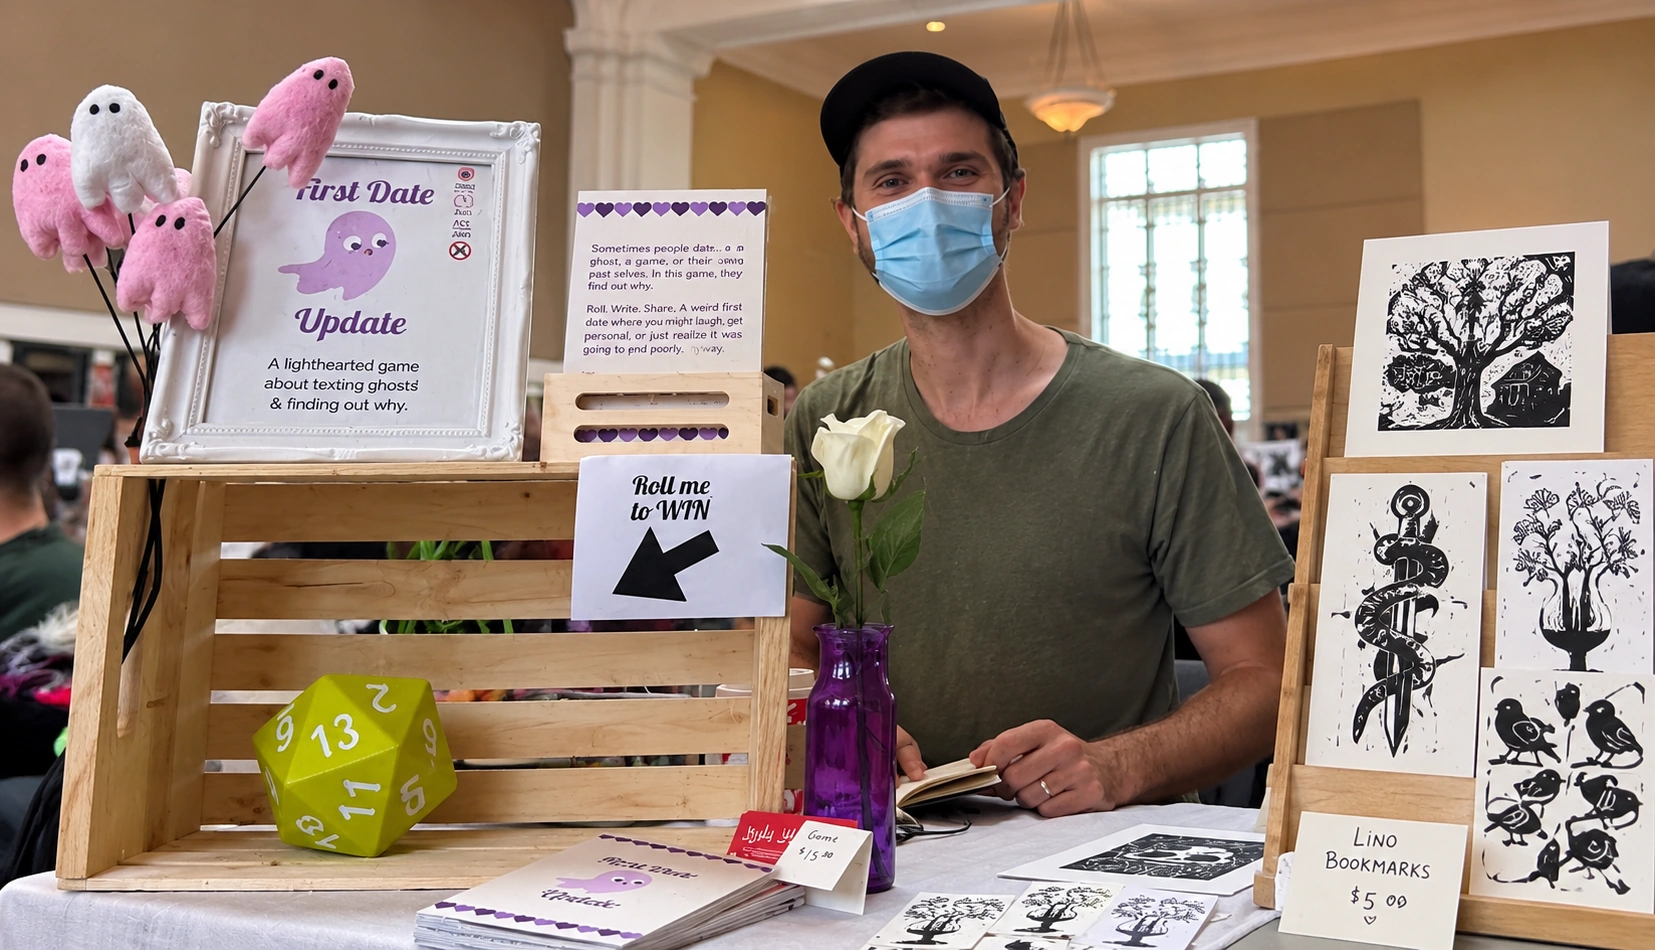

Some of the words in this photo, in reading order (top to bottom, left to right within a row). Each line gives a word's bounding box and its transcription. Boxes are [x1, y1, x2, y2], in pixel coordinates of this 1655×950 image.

[296, 177, 360, 202] First
[367, 180, 435, 205] Date
[591, 244, 650, 253] Sometimes
[654, 244, 689, 254] people
[590, 257, 622, 267] ghost,
[625, 258, 632, 266] a
[635, 258, 669, 267] game,
[672, 258, 684, 266] or
[688, 256, 713, 265] their
[589, 270, 611, 280] past
[614, 269, 649, 279] selves.
[652, 270, 661, 278] In
[664, 269, 683, 278] this
[686, 270, 718, 280] game,
[720, 269, 743, 280] they
[588, 282, 608, 291] find
[611, 283, 627, 291] out
[630, 282, 654, 292] why.
[586, 304, 608, 314] Roll.
[611, 304, 641, 313] Write.
[644, 304, 676, 313] Share.
[679, 303, 687, 312] A
[690, 303, 719, 312] weird
[722, 302, 743, 312] first
[294, 308, 407, 341] Update
[585, 318, 609, 327] date
[611, 318, 642, 327] where
[645, 319, 663, 328] you
[665, 318, 693, 328] might
[695, 317, 725, 328] laugh,
[727, 318, 743, 327] get
[584, 331, 632, 343] personal,
[635, 332, 646, 340] or
[649, 331, 669, 341] just
[721, 331, 743, 339] was
[583, 344, 611, 356] going
[615, 345, 625, 354] to
[650, 344, 684, 356] poorly.
[268, 358, 280, 370] A
[284, 357, 374, 373] lighthearted
[378, 361, 420, 375] game
[264, 377, 309, 391] about
[313, 379, 364, 393] texting
[367, 379, 419, 394] ghosts
[270, 397, 282, 410] &
[287, 397, 339, 414] finding
[344, 400, 369, 412] out
[374, 399, 408, 414] why.
[632, 475, 676, 496] Roll
[679, 479, 711, 495] me
[630, 502, 653, 521] to
[656, 499, 711, 521] WIN
[311, 713, 360, 758] 13
[1325, 850, 1431, 879] BOOKMARKS
[1351, 886, 1377, 910] $5
